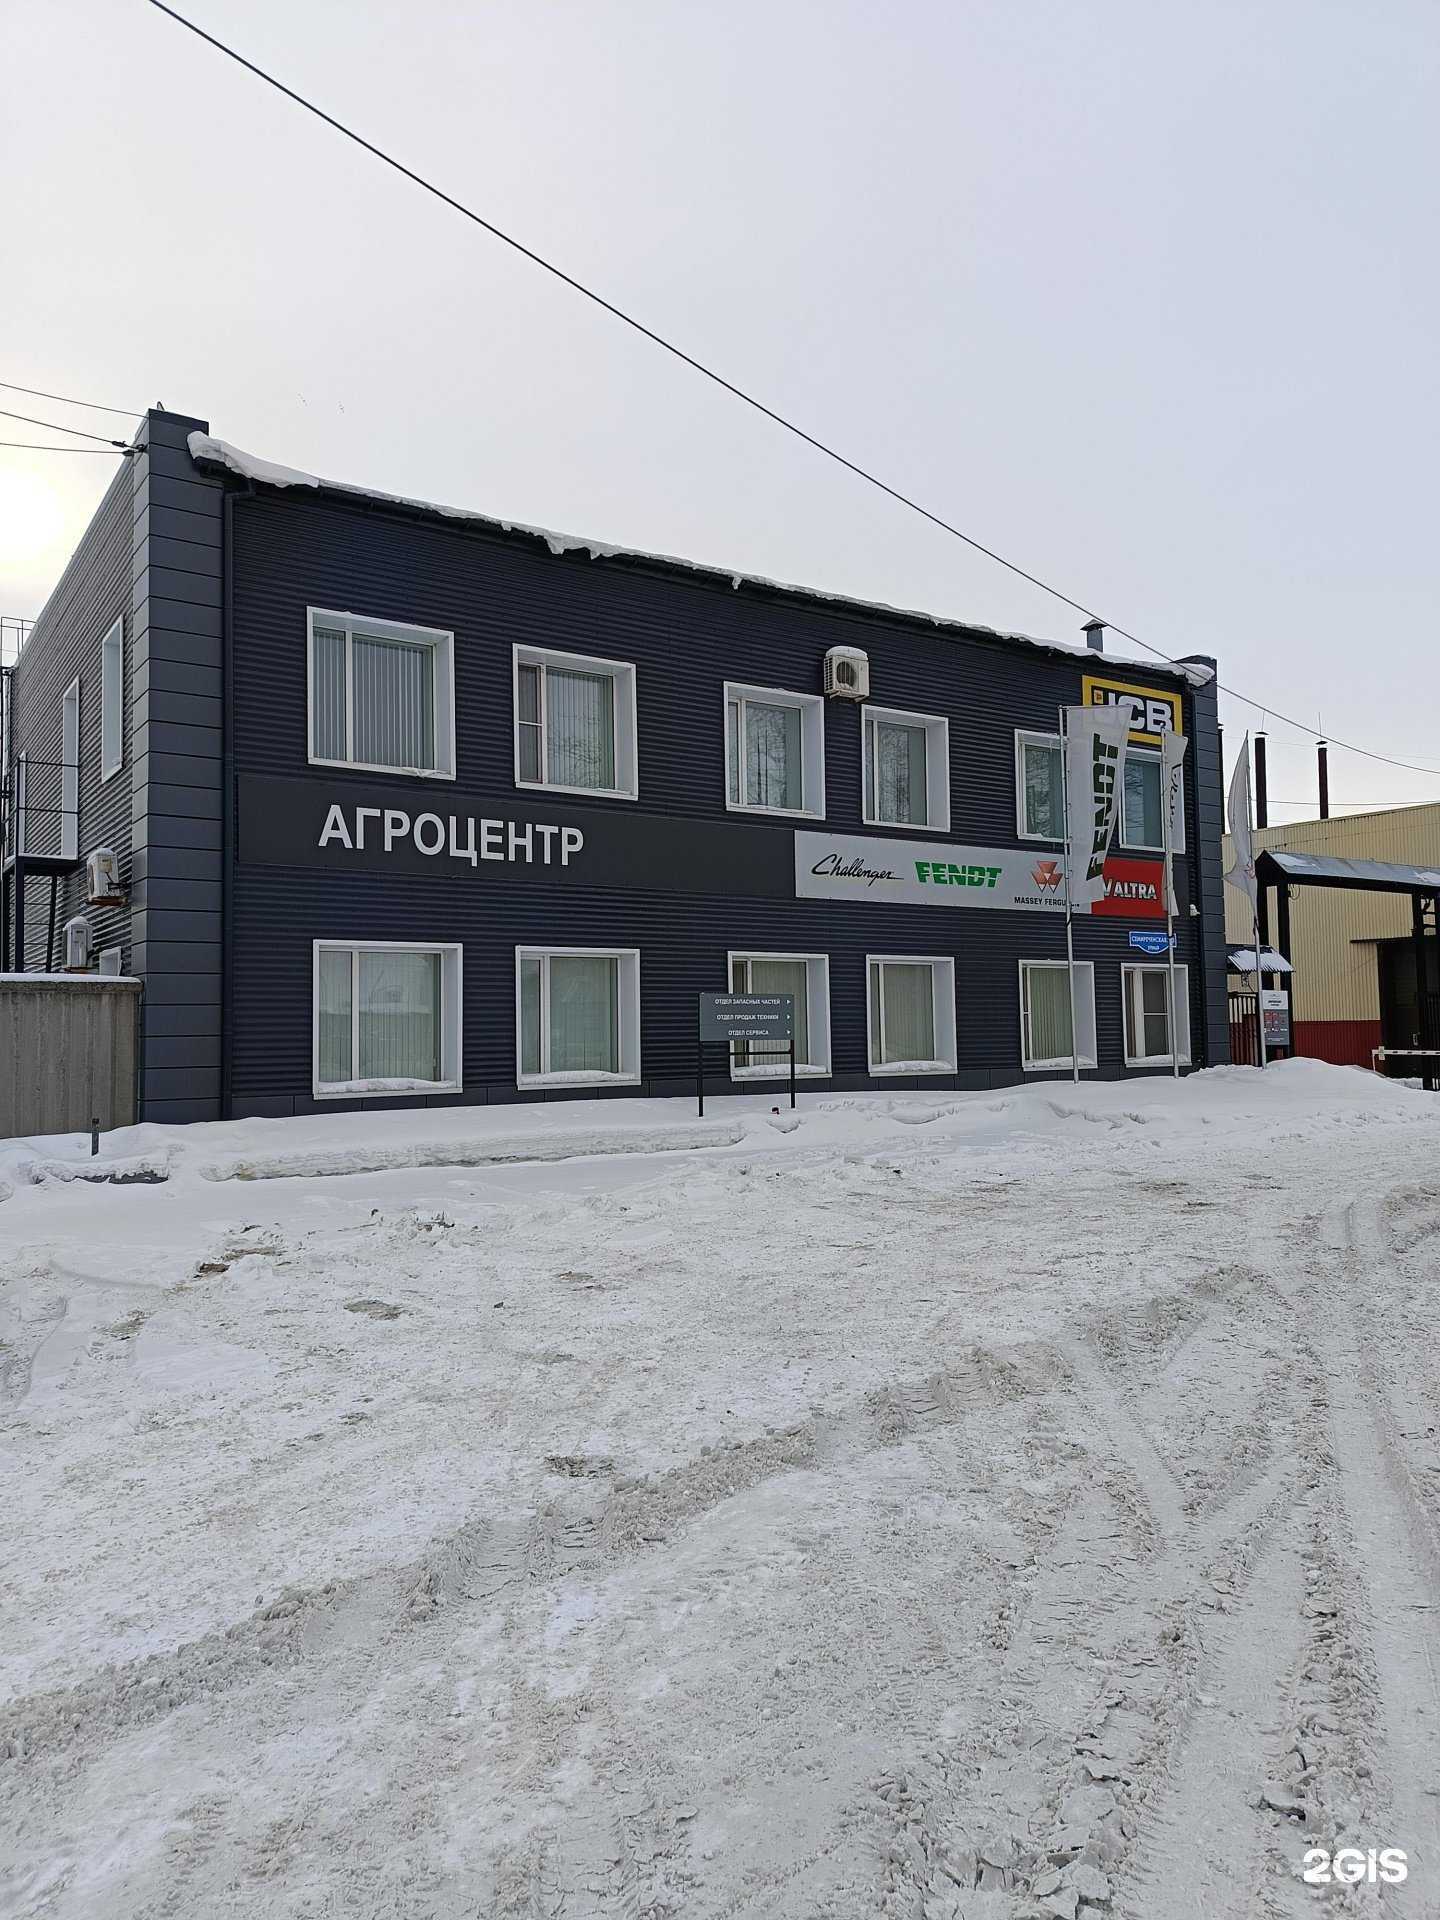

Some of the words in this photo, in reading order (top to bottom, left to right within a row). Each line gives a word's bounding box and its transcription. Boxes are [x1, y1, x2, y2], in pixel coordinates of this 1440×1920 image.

[1086, 733, 1118, 881] FENDT
[318, 804, 585, 868] АГРОЦЕНТР
[811, 853, 904, 887] Challenger
[914, 861, 1003, 888] FENDT
[1014, 896, 1043, 906] MASSEY
[761, 997, 781, 1005] ЧАСТЕЙ
